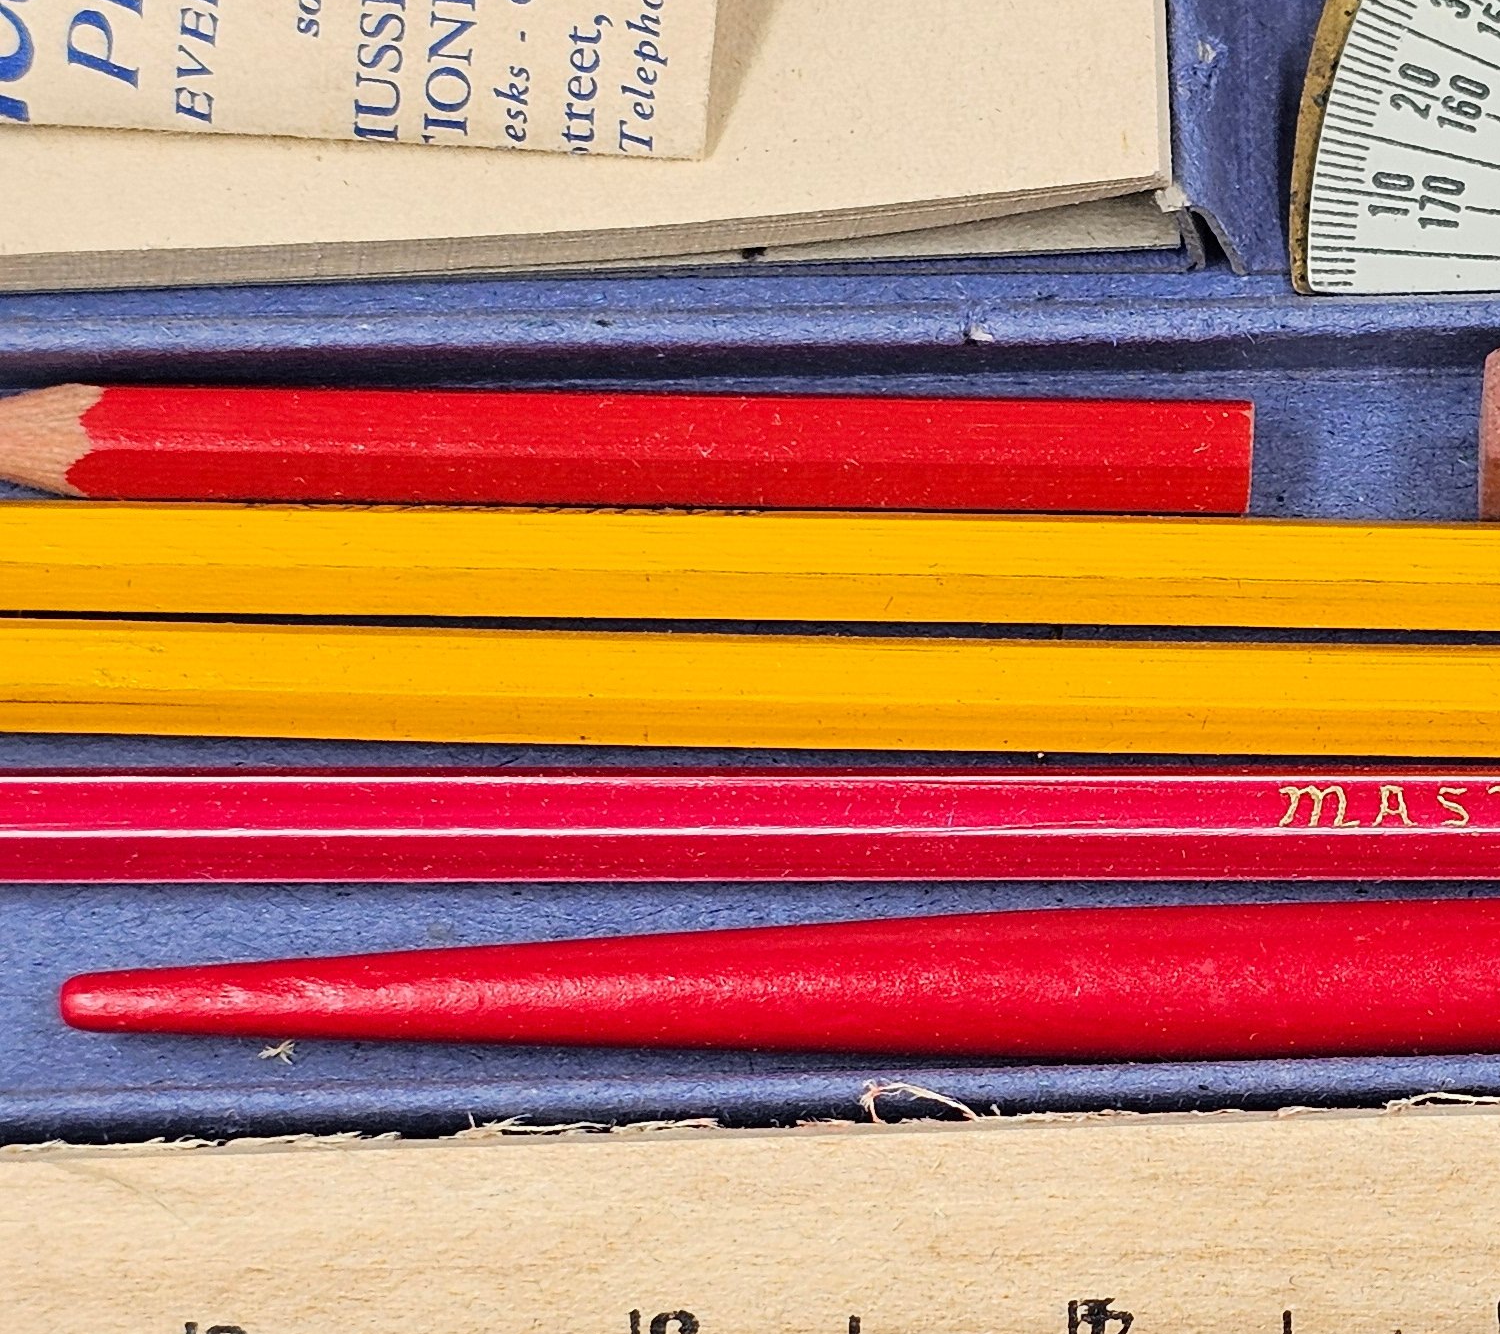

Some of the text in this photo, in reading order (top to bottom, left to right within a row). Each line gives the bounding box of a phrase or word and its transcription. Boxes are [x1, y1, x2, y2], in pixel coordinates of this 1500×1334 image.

[491, 64, 531, 149] esks
[1390, 63, 1440, 119] 20
[1437, 75, 1490, 133] 160
[1368, 172, 1414, 216] 10
[1418, 175, 1465, 229] 170
